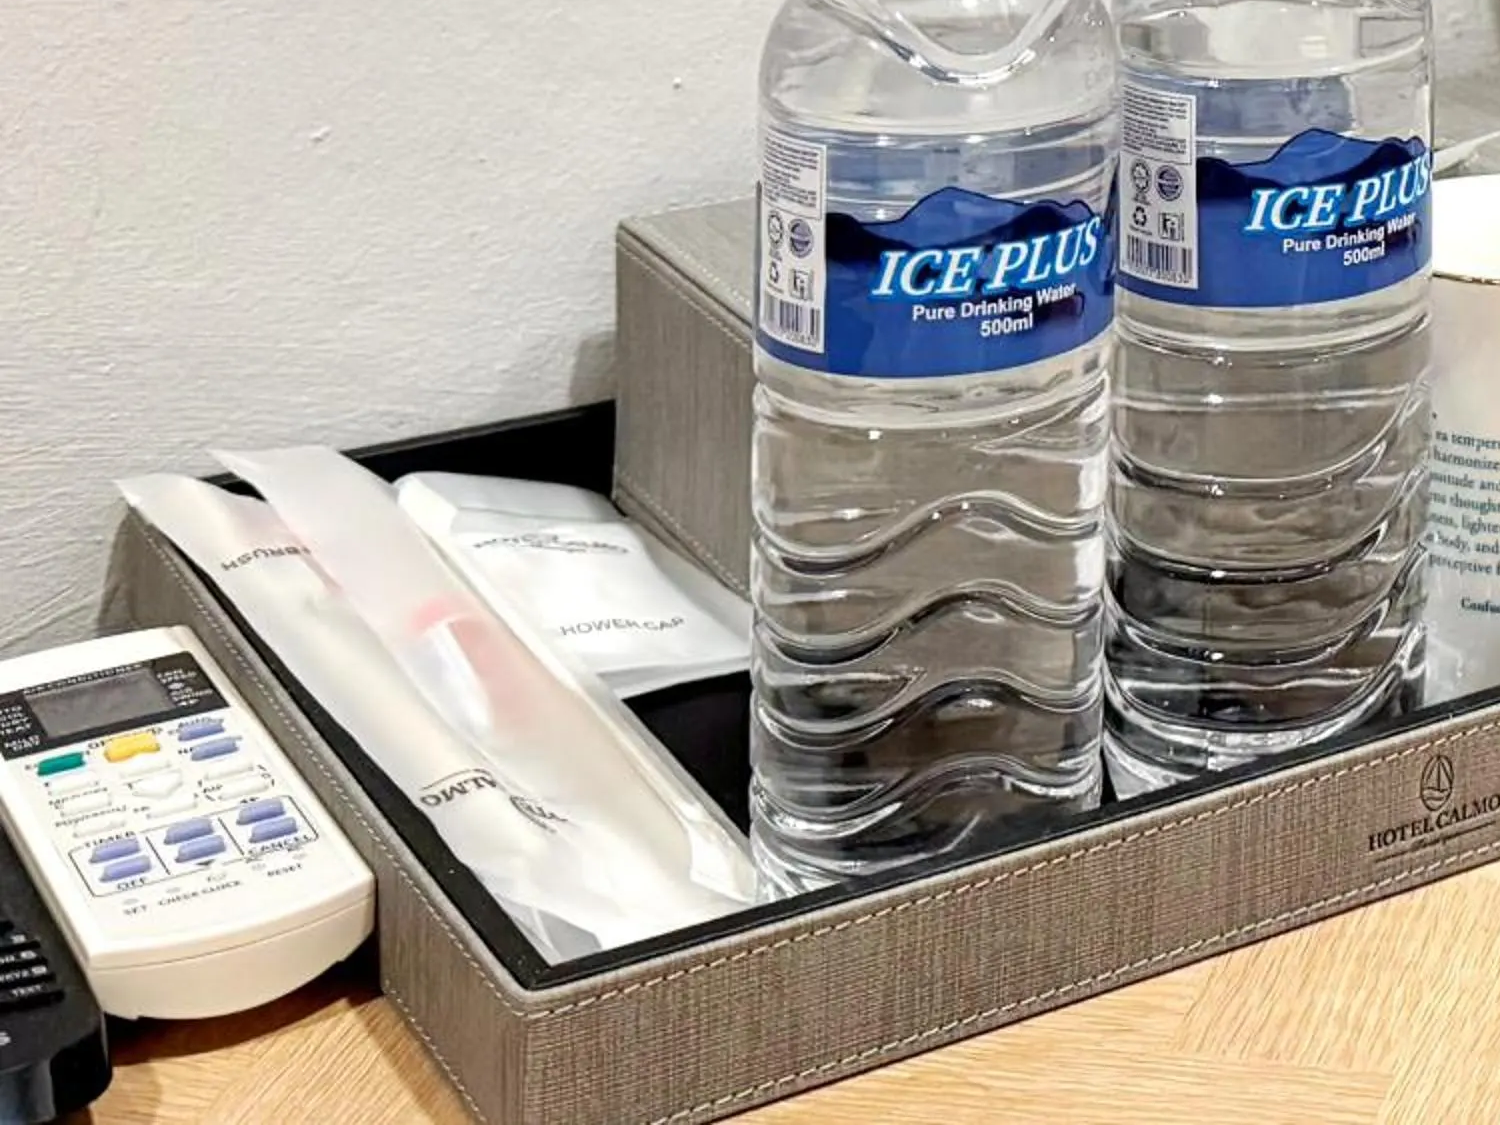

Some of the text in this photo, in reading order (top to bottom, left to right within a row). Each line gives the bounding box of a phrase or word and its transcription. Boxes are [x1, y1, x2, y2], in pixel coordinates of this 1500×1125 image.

[1245, 151, 1433, 232] ICE PLUS
[1283, 211, 1416, 254] Pure Drinking Water
[872, 215, 1101, 296] ICE PLUS
[1343, 242, 1385, 266] 500ml
[912, 283, 1077, 322] Pure Drinking Water
[980, 313, 1034, 337] 500ml
[1475, 539, 1500, 555] and
[559, 618, 640, 636] HOWER
[420, 775, 497, 807] ALMO
[83, 831, 136, 848] TIMER
[1368, 818, 1435, 851] HOTEL
[116, 876, 149, 892] OFF
